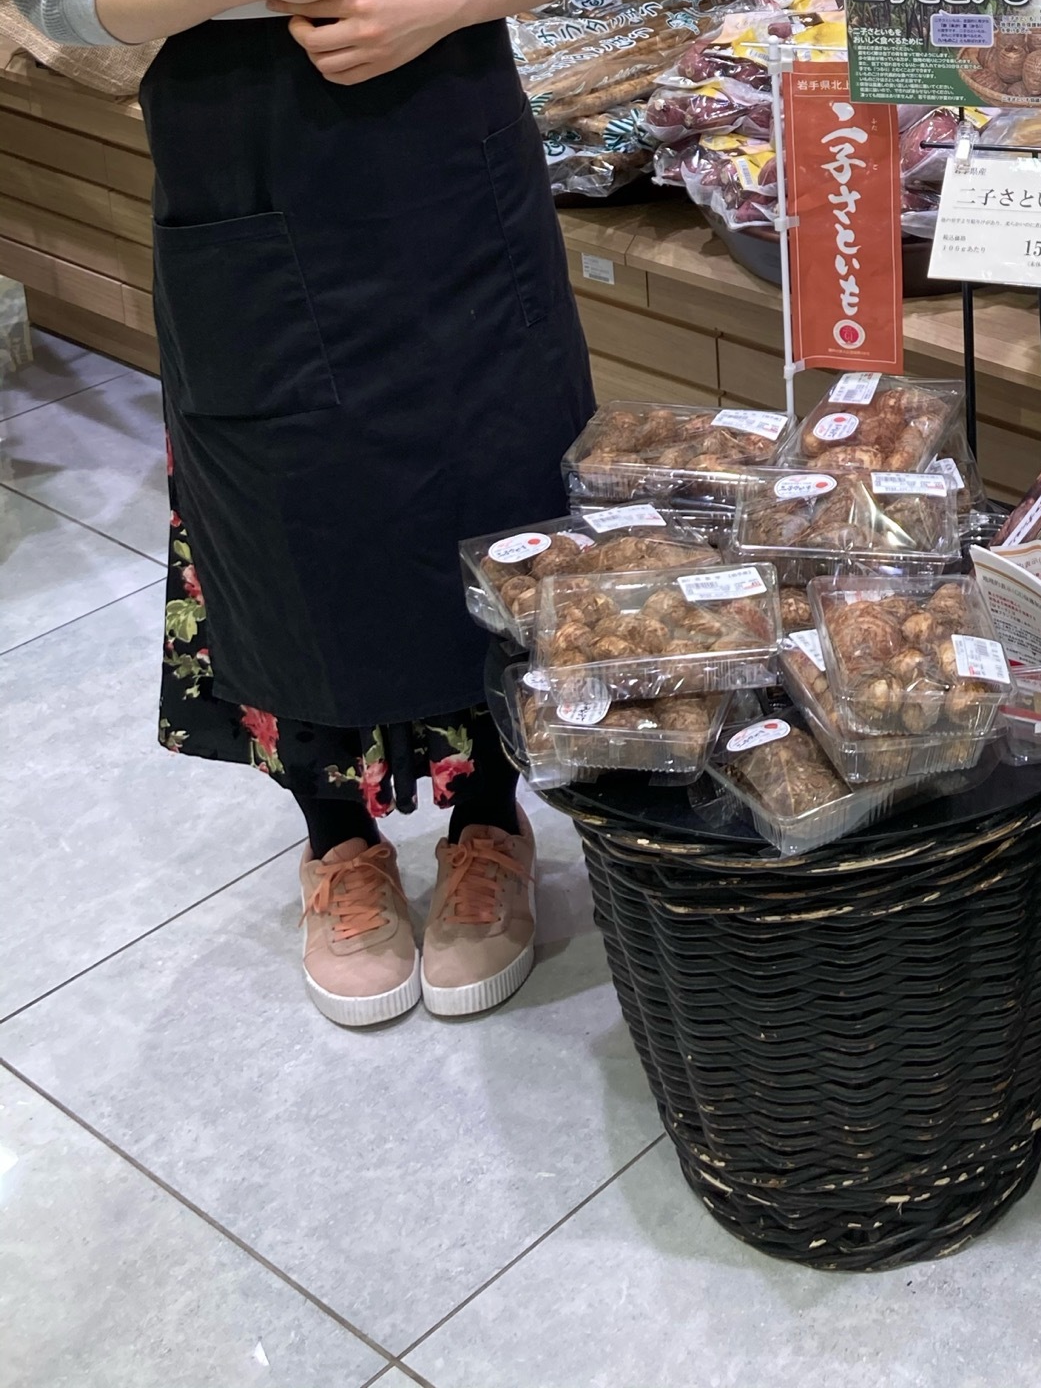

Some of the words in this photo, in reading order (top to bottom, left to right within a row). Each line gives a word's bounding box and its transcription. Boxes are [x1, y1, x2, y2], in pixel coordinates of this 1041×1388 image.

[852, 27, 902, 36] 二子さといもを
[853, 36, 924, 46] おいしく食べるために
[821, 101, 869, 317] 二子さといも
